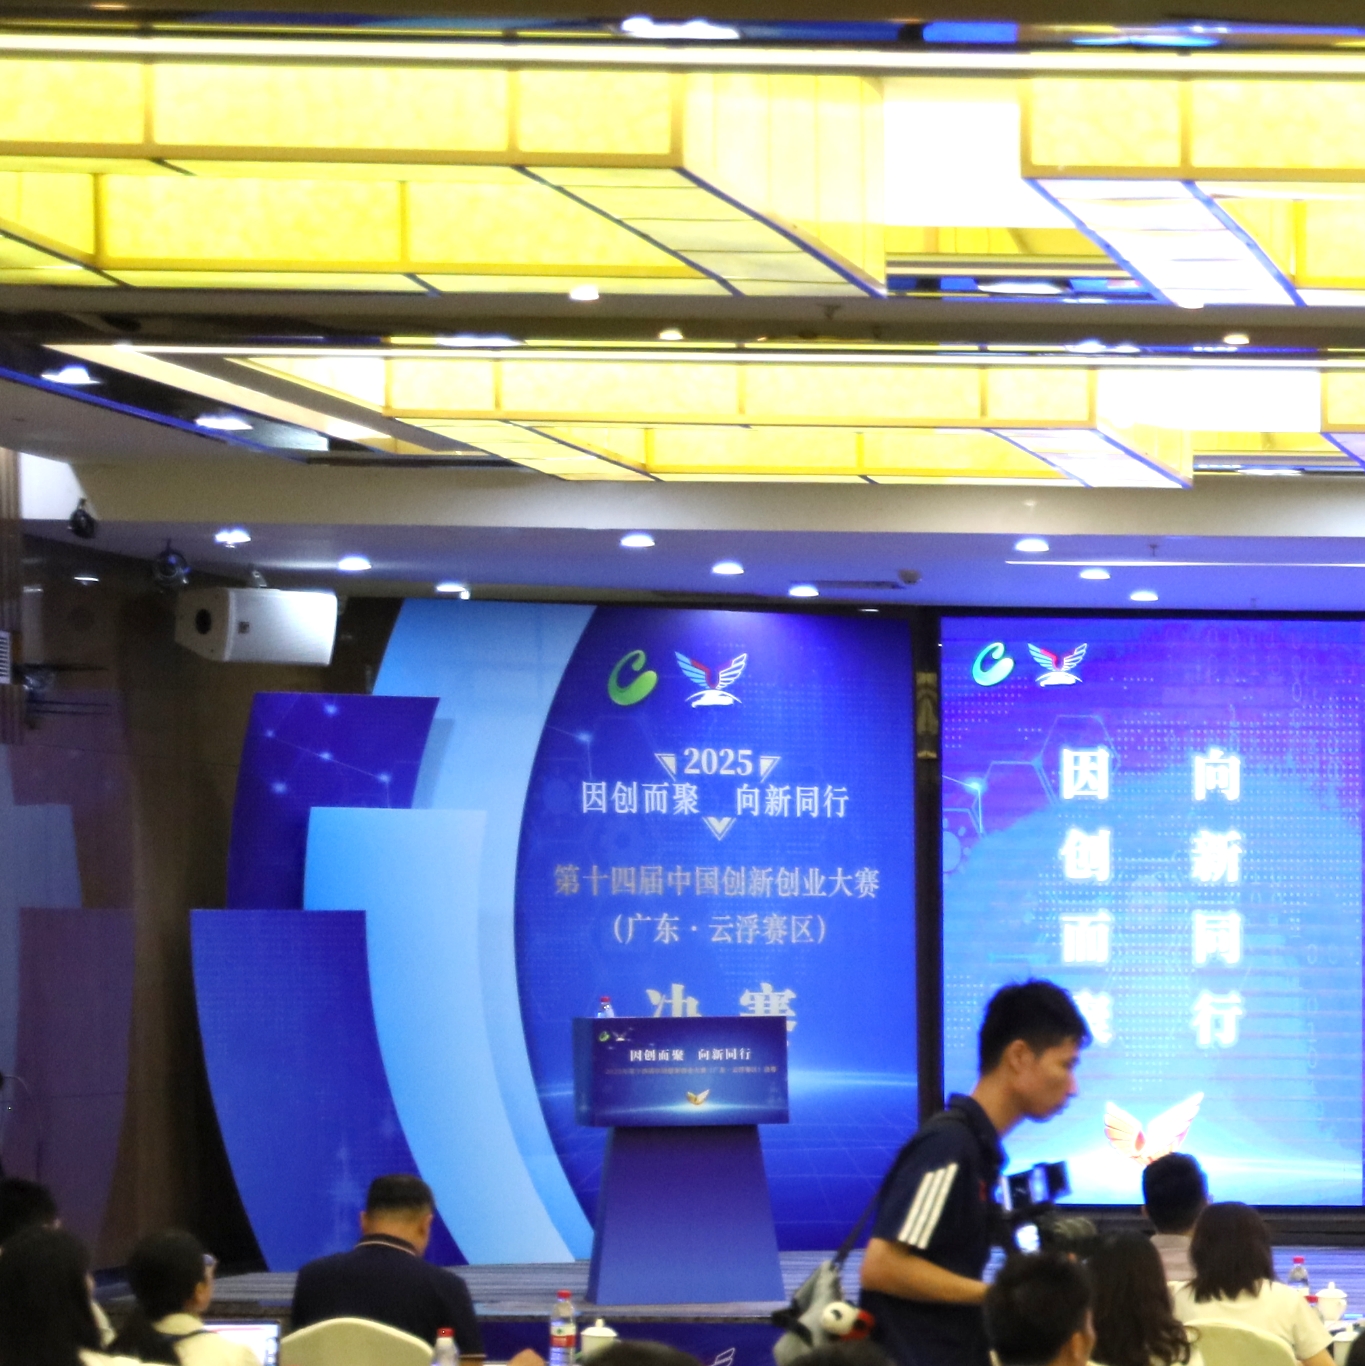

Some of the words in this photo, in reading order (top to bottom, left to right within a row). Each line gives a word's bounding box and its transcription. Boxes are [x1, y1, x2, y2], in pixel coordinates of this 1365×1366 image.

[683, 748, 753, 776] 2025
[581, 781, 699, 815] 因创而聚
[736, 784, 849, 819] 向新同行
[554, 865, 880, 899] 第十四届中国创新创业大赛
[630, 1048, 684, 1062] 因创而聚
[698, 1047, 751, 1061] 向新同行
